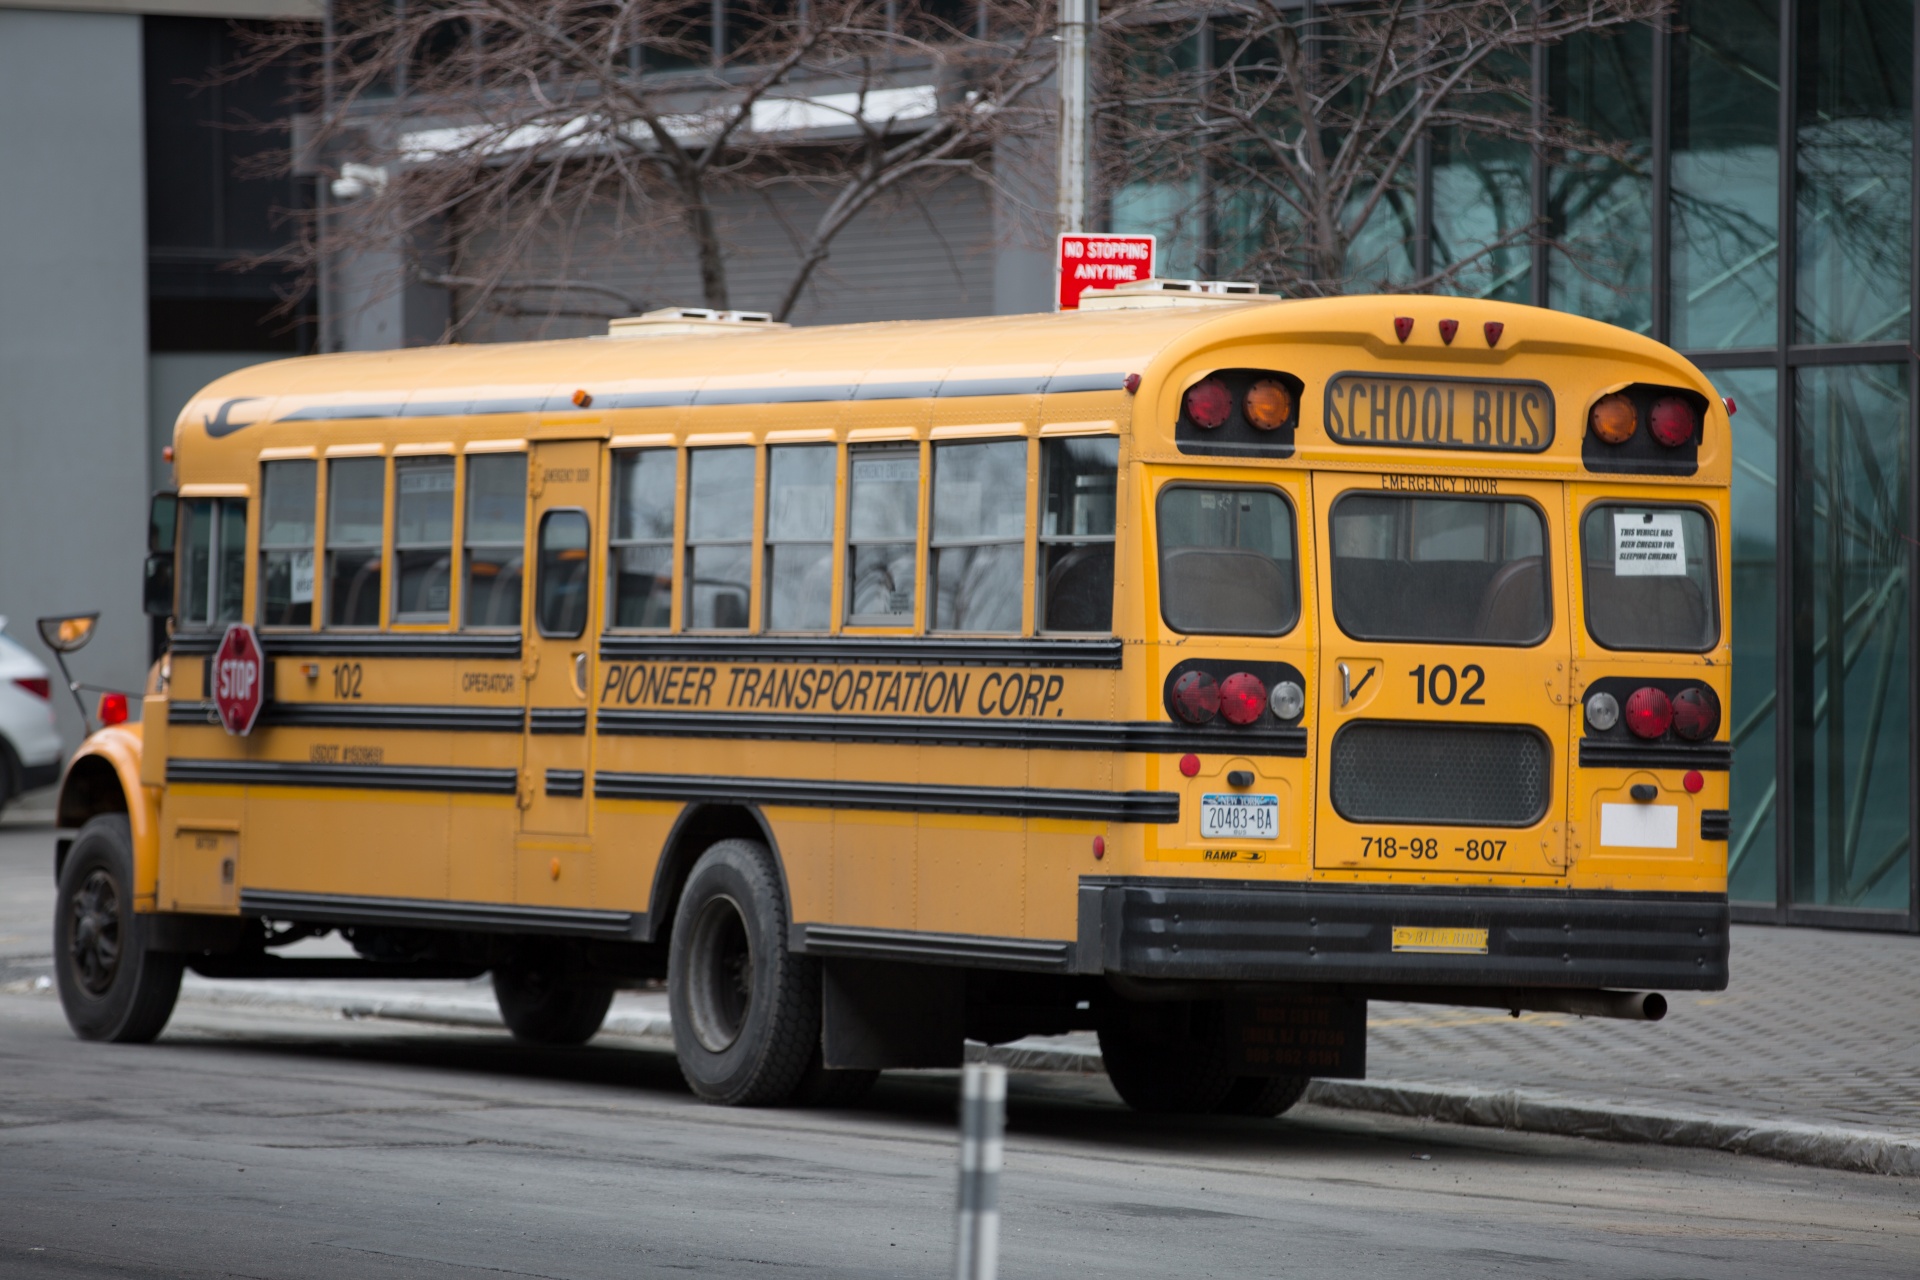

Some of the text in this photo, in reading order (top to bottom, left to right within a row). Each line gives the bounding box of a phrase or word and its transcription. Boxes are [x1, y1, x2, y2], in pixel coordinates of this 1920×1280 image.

[1064, 241, 1149, 260] NO STOPPING
[1074, 263, 1137, 280] ANYTIME
[1330, 382, 1541, 447] SCHOOL BUS
[1381, 475, 1498, 494] EMERGENCY DOOR
[1620, 528, 1673, 537] THIS VEHICLE HAS
[1620, 541, 1675, 549] BEEN CHECKED FOR
[1620, 552, 1677, 561] SLEEPING CHILDREN
[220, 659, 257, 700] STOP
[332, 662, 363, 699] 102
[462, 672, 515, 694] OPERATOR
[1408, 664, 1486, 706] 102
[602, 664, 1065, 718] PIONEER TRANSPORTATION CORP.
[1205, 850, 1238, 860] RAMP
